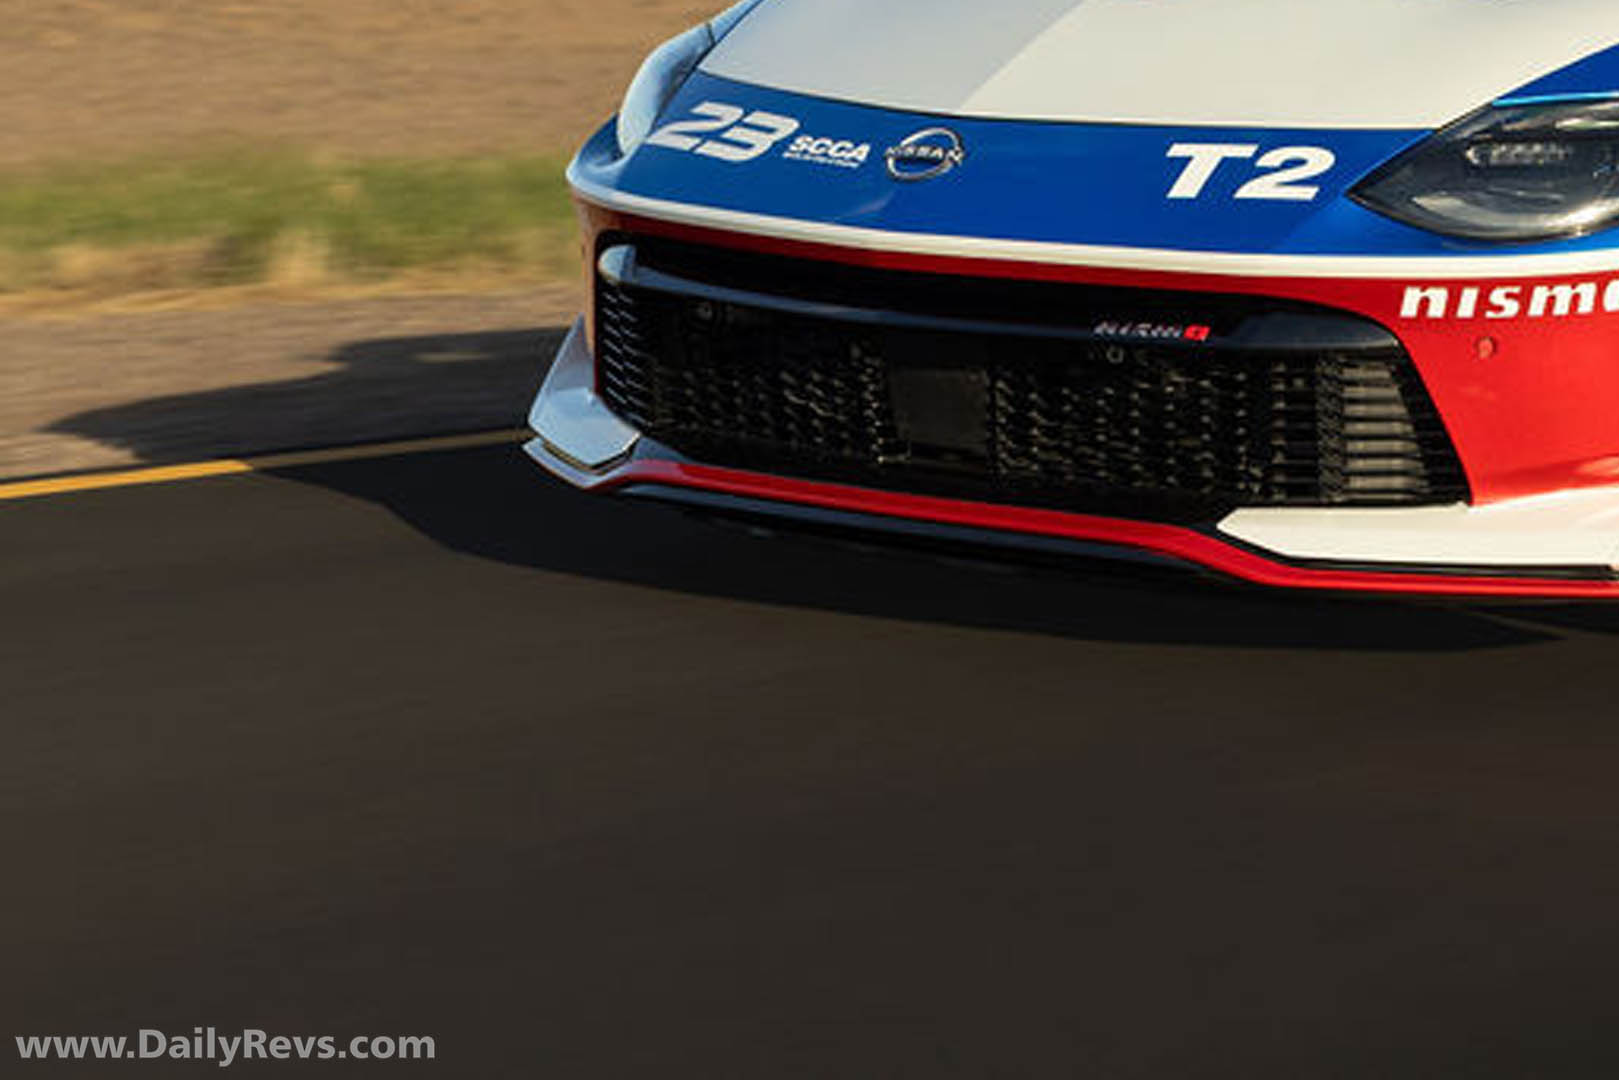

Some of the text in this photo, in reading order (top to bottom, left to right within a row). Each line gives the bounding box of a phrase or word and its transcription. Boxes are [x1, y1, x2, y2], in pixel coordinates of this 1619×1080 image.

[646, 101, 799, 162] 23
[789, 135, 870, 162] SCCA
[885, 144, 963, 165] NISSAN
[1165, 143, 1336, 201] T2
